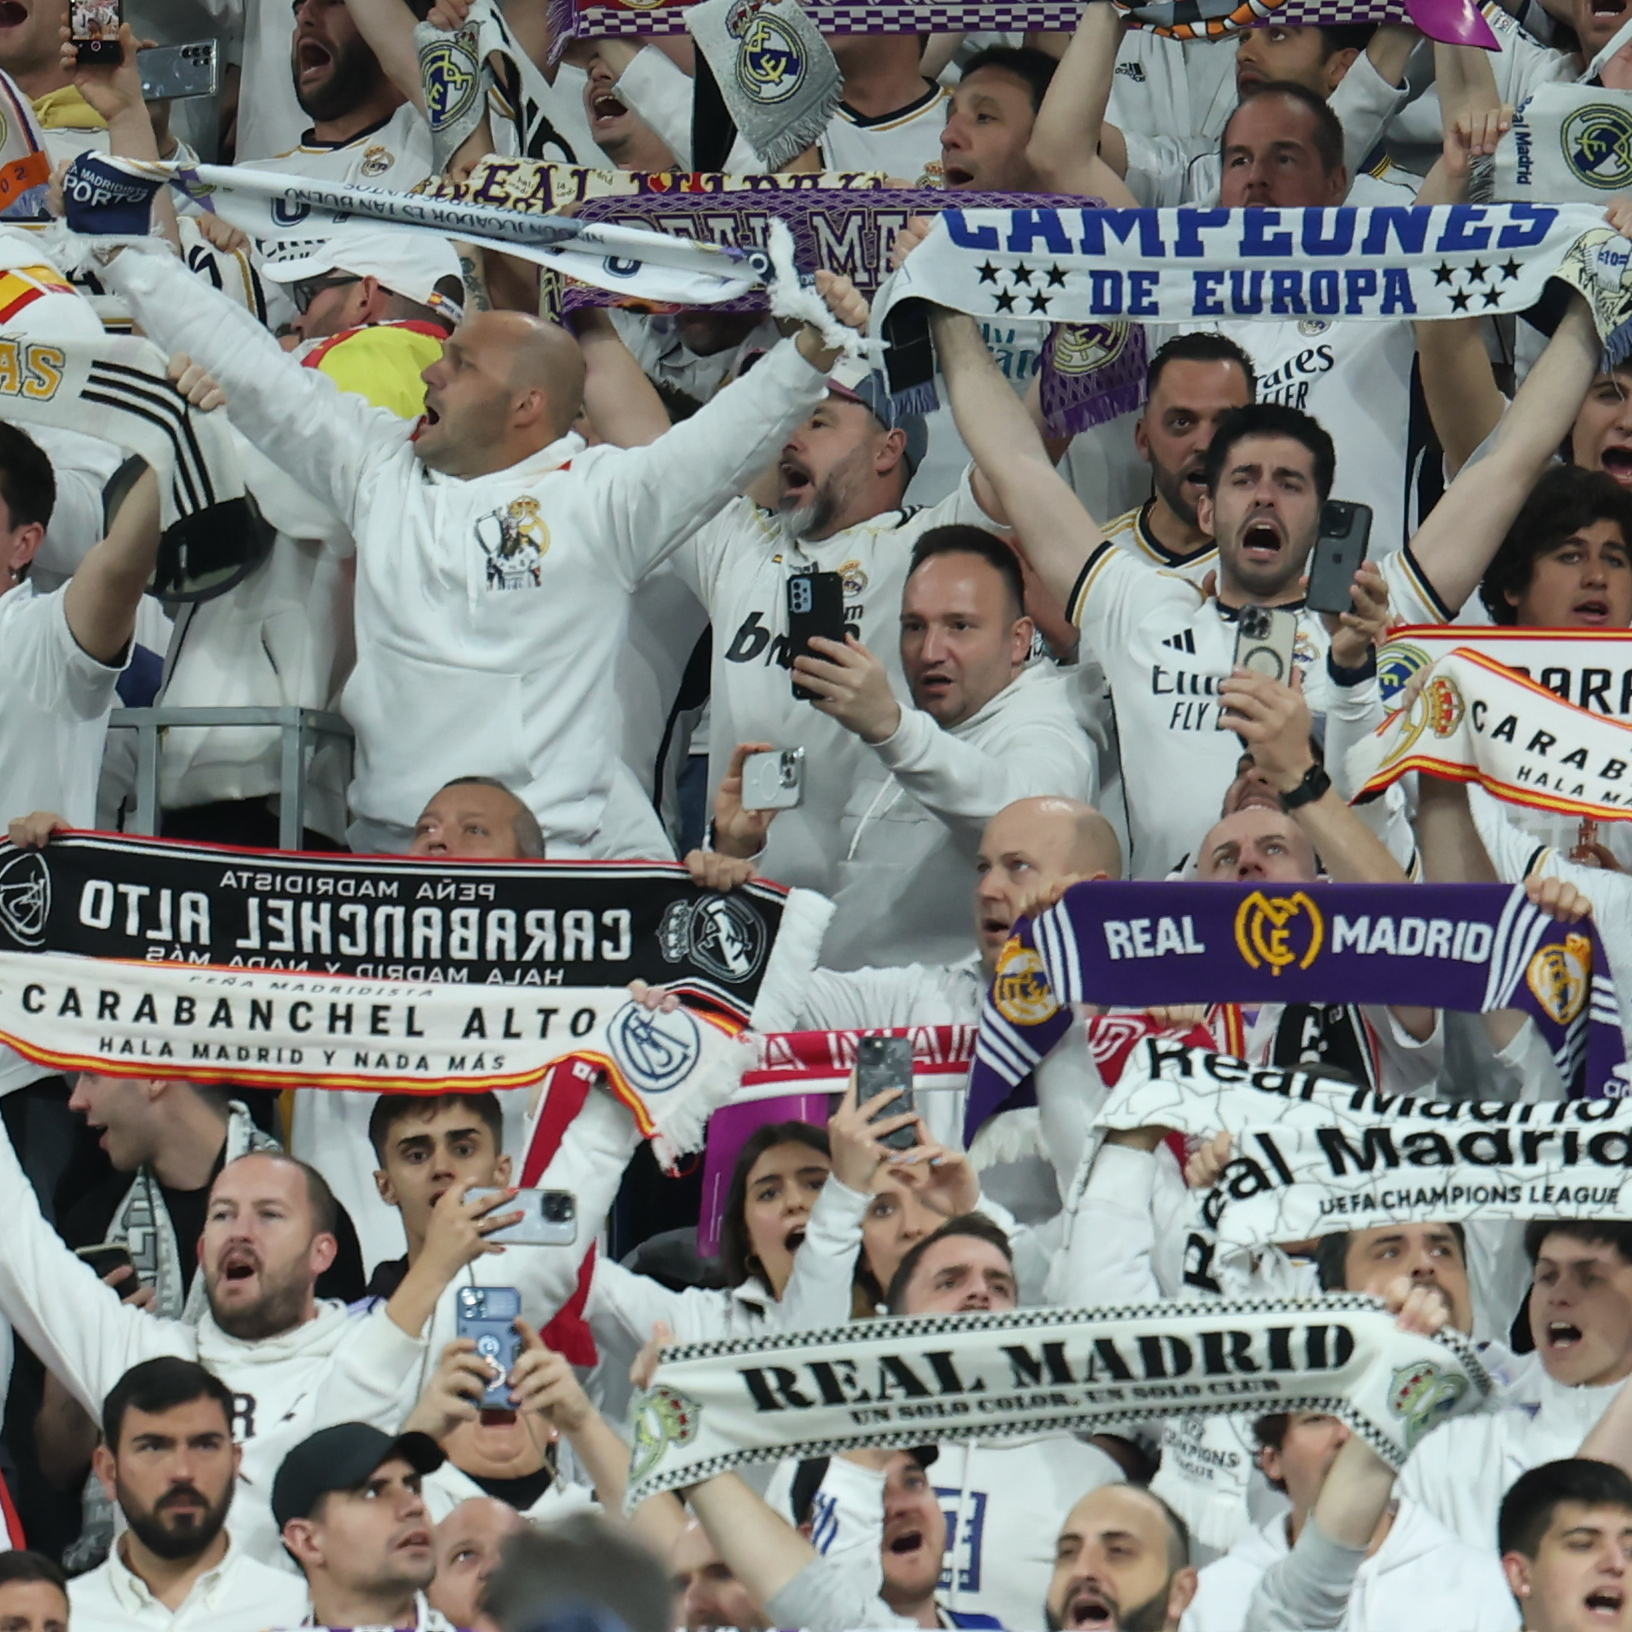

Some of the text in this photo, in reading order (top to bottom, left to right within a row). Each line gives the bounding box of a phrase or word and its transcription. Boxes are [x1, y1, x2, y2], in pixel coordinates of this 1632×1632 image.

[1516, 128, 1534, 186] Madrid
[945, 204, 1560, 258] CAMPEONES
[1089, 268, 1417, 317] DE EUROPA
[1516, 765, 1587, 798] HALA
[1103, 913, 1495, 965] REAL MADRID
[20, 982, 598, 1041] CARABANCHEL ALTO
[98, 1036, 507, 1072] HALA MADRID NADA MÁS
[1320, 1183, 1622, 1217] UEFA CHAMPIONS LEAGUE
[741, 1322, 1357, 1412] REAL MADRID
[898, 1375, 1280, 1424] SOLO SOLO CLUB
